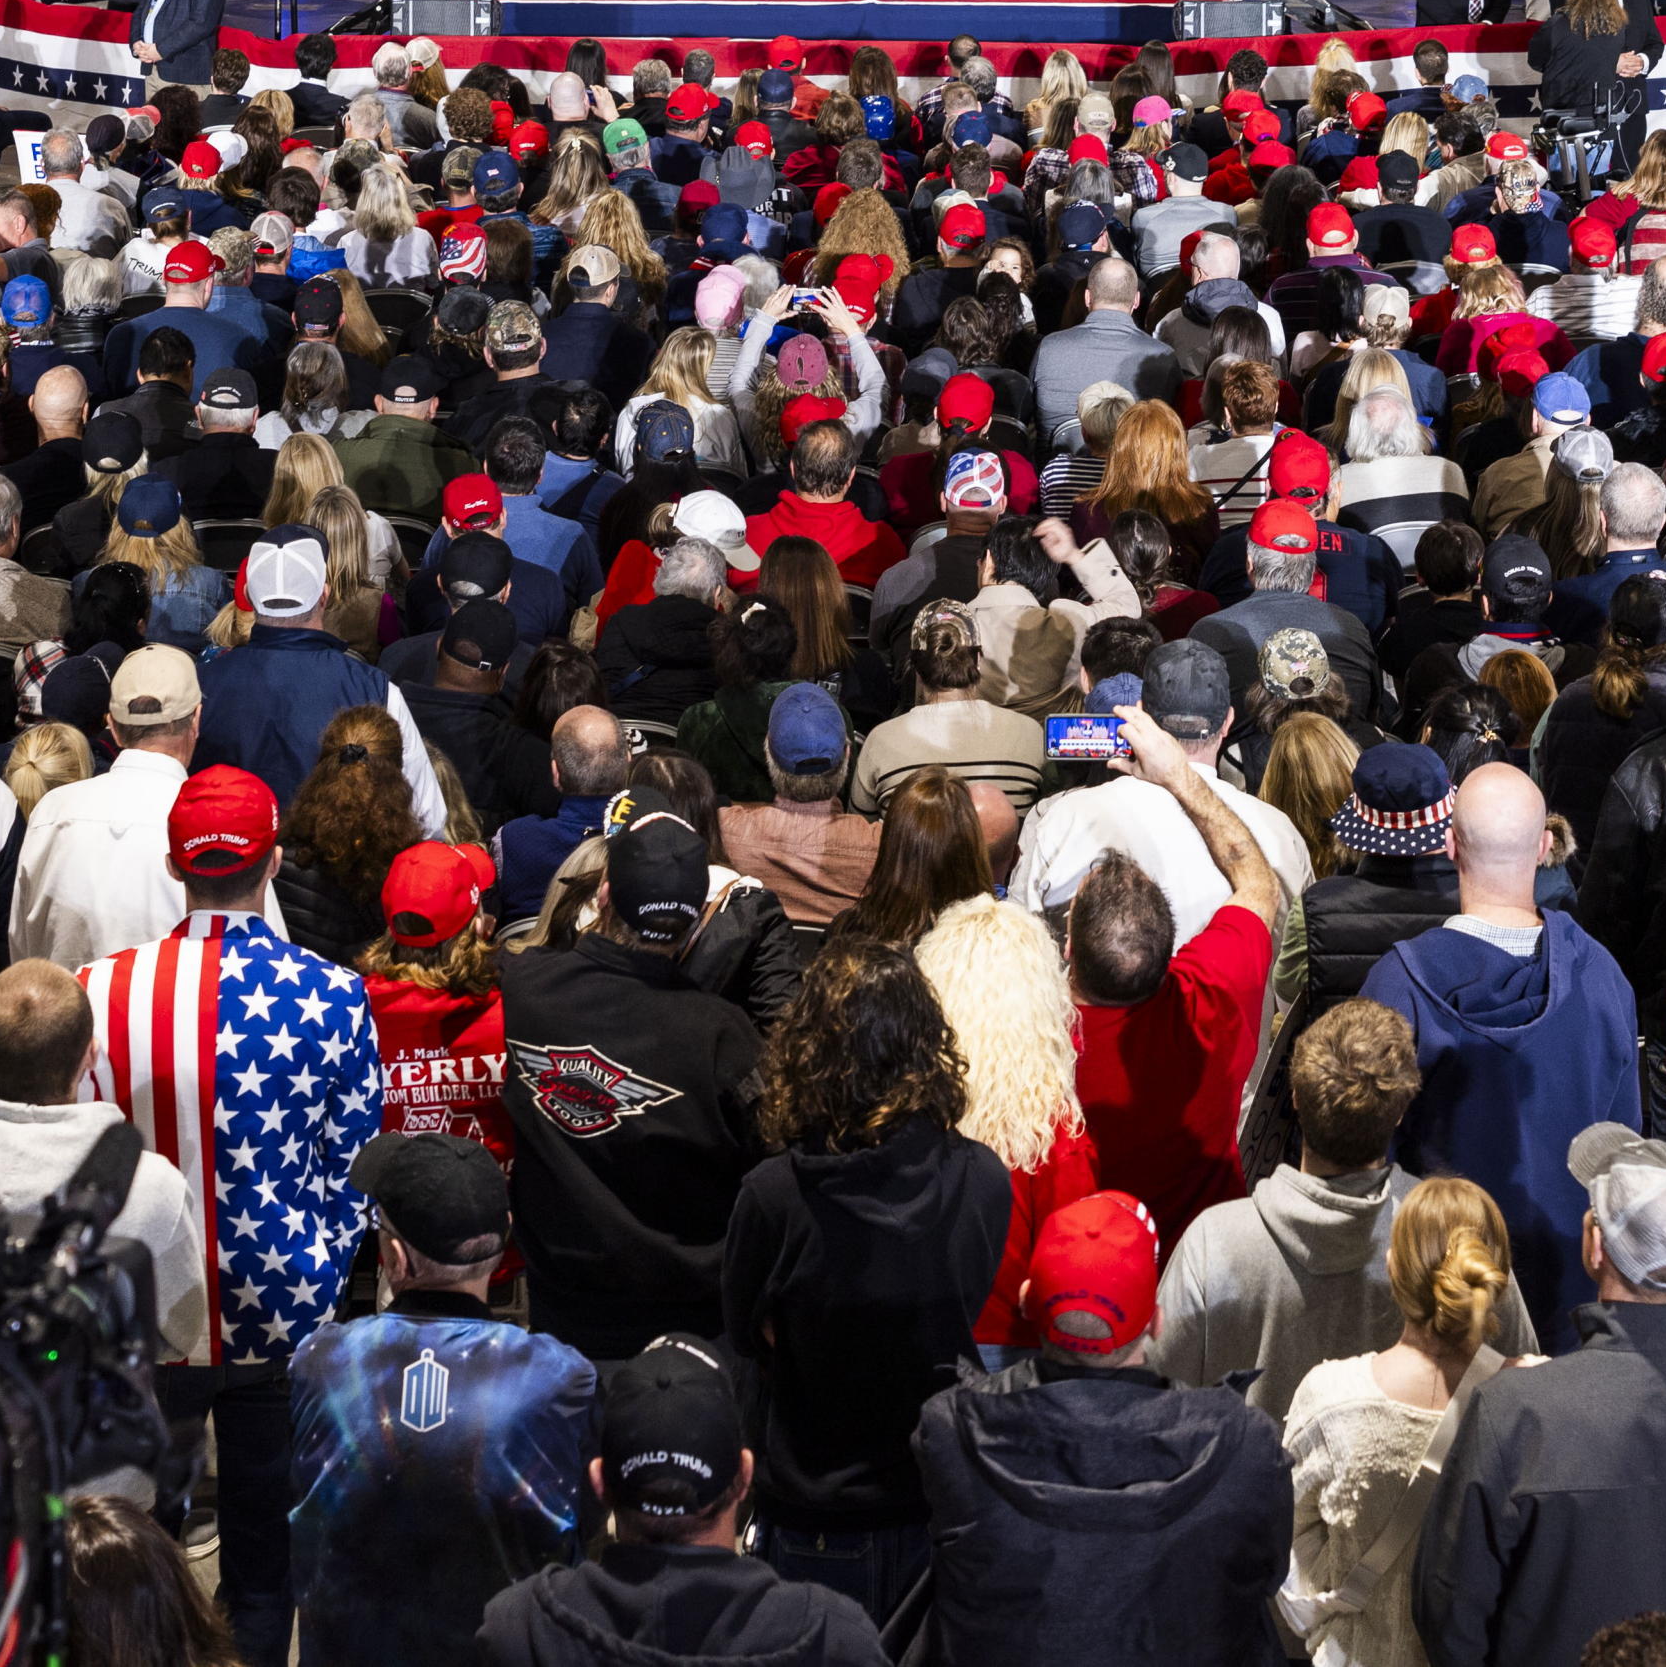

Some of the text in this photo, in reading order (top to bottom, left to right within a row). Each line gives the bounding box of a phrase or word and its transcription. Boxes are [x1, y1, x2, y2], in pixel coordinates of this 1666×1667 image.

[1504, 566, 1543, 578] DONALD TRUMP
[183, 833, 249, 852] DONALD TRUMP
[638, 901, 677, 916] DONALD
[396, 1046, 450, 1060] J. Mark
[559, 1057, 612, 1087] QUALITY
[412, 1085, 475, 1106] BUILDER,
[551, 1101, 604, 1128] TOOLS
[1045, 1289, 1127, 1323] DONALD TRUMP
[621, 1450, 712, 1478] DONALD TRUMP
